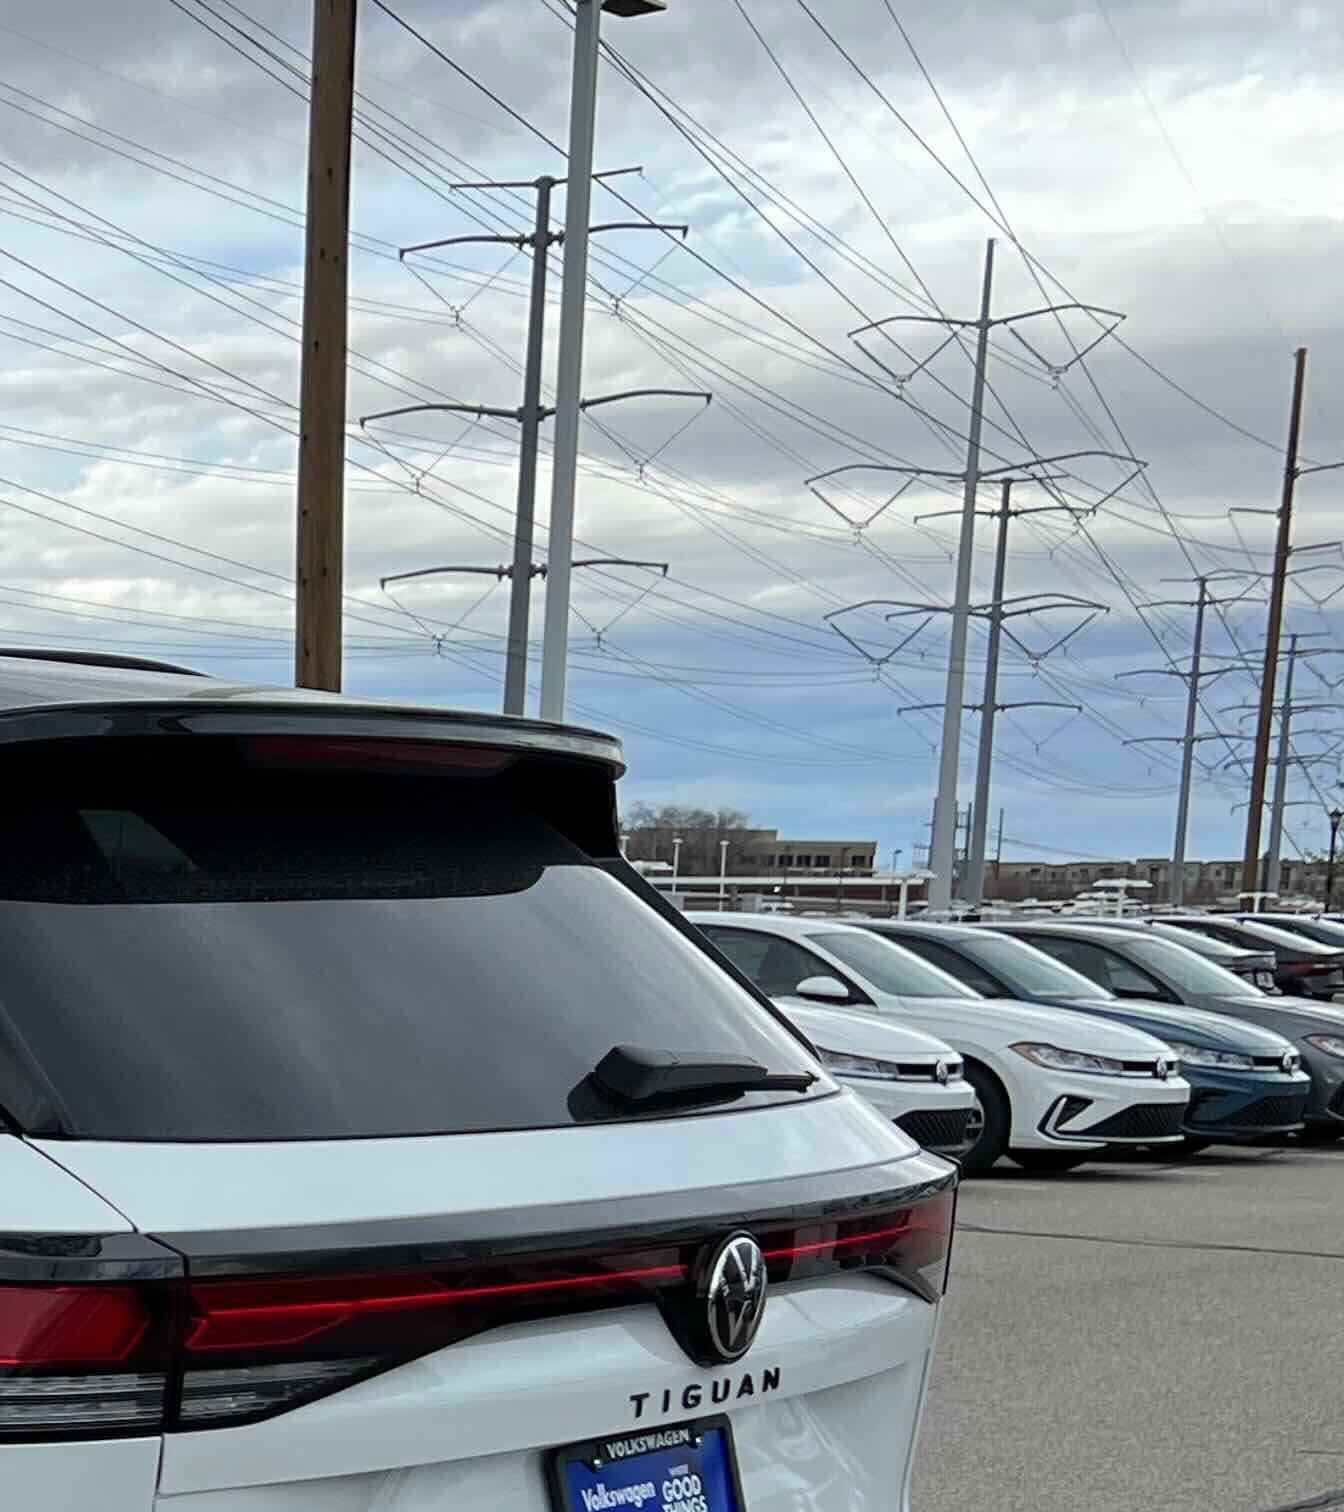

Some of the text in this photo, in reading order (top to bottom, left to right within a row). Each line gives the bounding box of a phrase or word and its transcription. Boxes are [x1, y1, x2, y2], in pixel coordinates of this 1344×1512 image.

[630, 1367, 780, 1418] TIGUAN
[606, 1429, 690, 1458] VOLKSWAGEN
[581, 1481, 657, 1512] Volkswagen
[662, 1474, 702, 1502] GOOD
